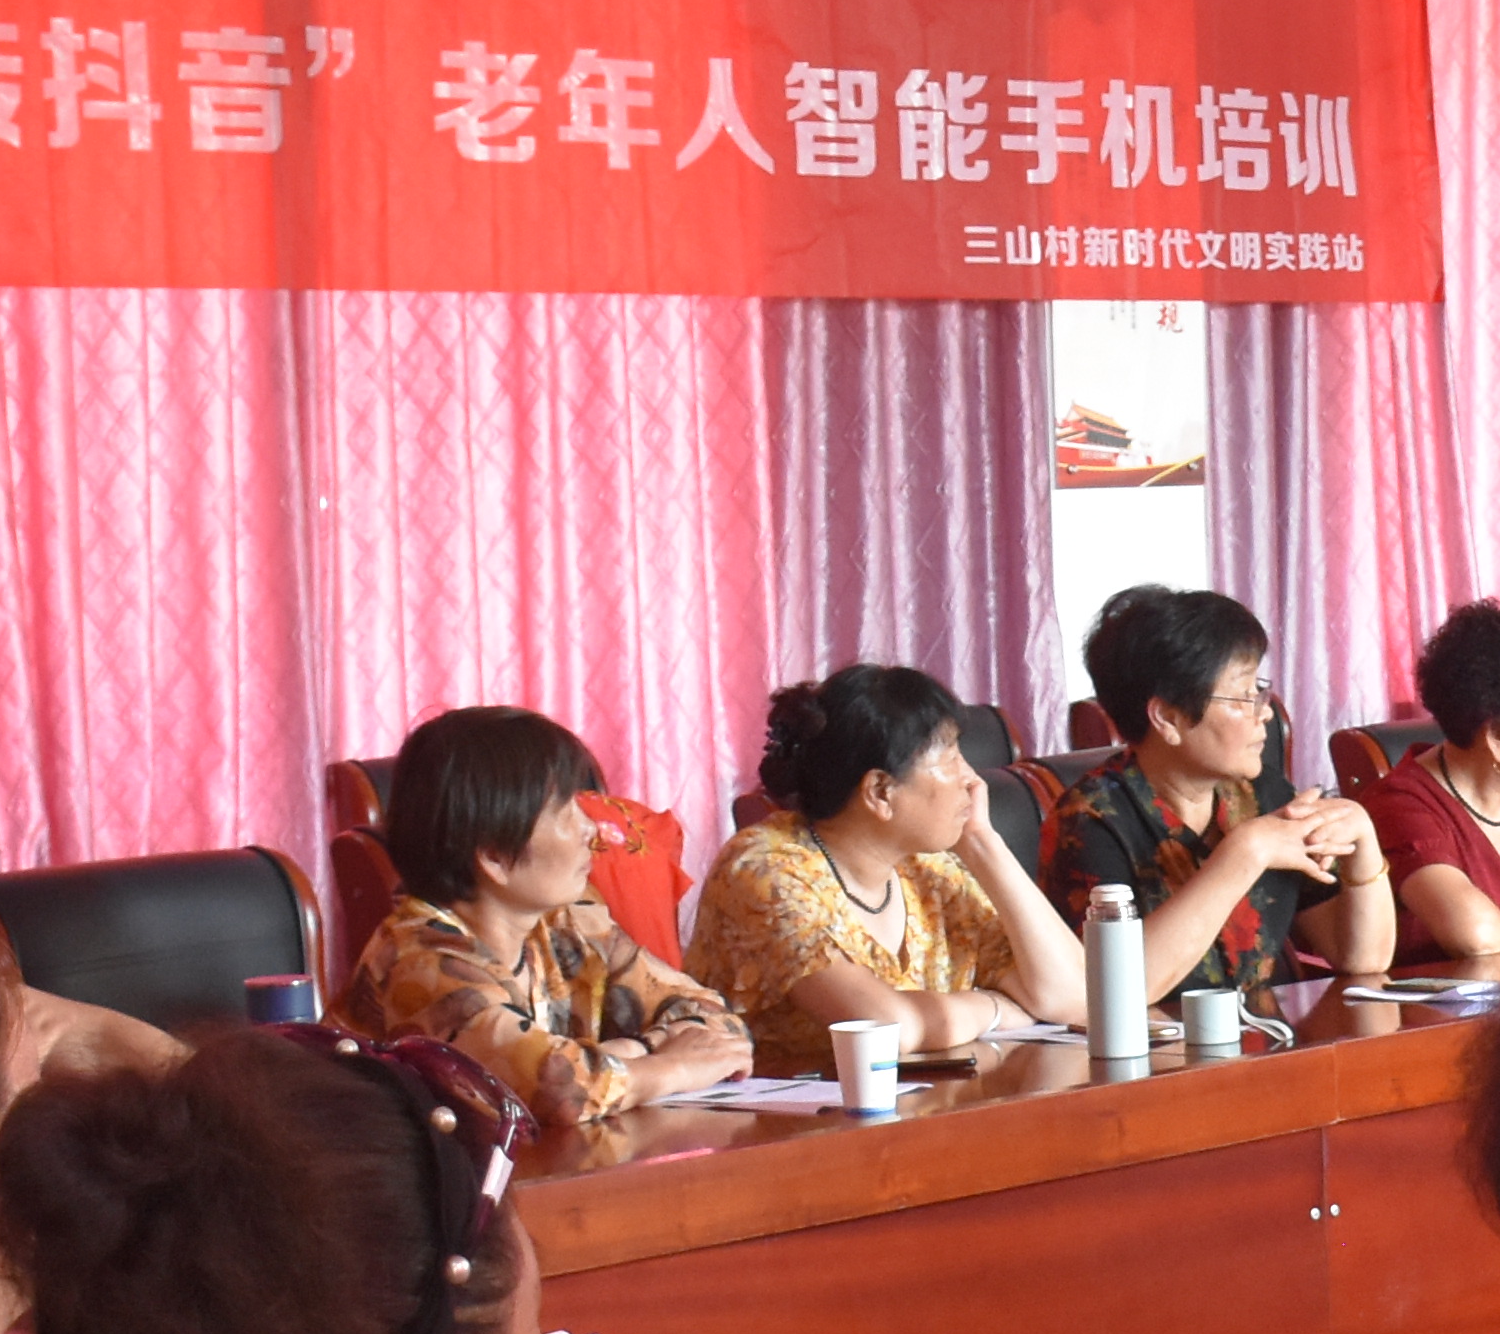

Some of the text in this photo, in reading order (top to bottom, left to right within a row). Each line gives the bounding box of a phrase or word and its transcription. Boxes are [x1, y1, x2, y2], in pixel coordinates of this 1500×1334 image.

[432, 40, 1359, 199] 老年人智能手机培训
[962, 224, 1366, 273] 三山村新时代文明实践站
